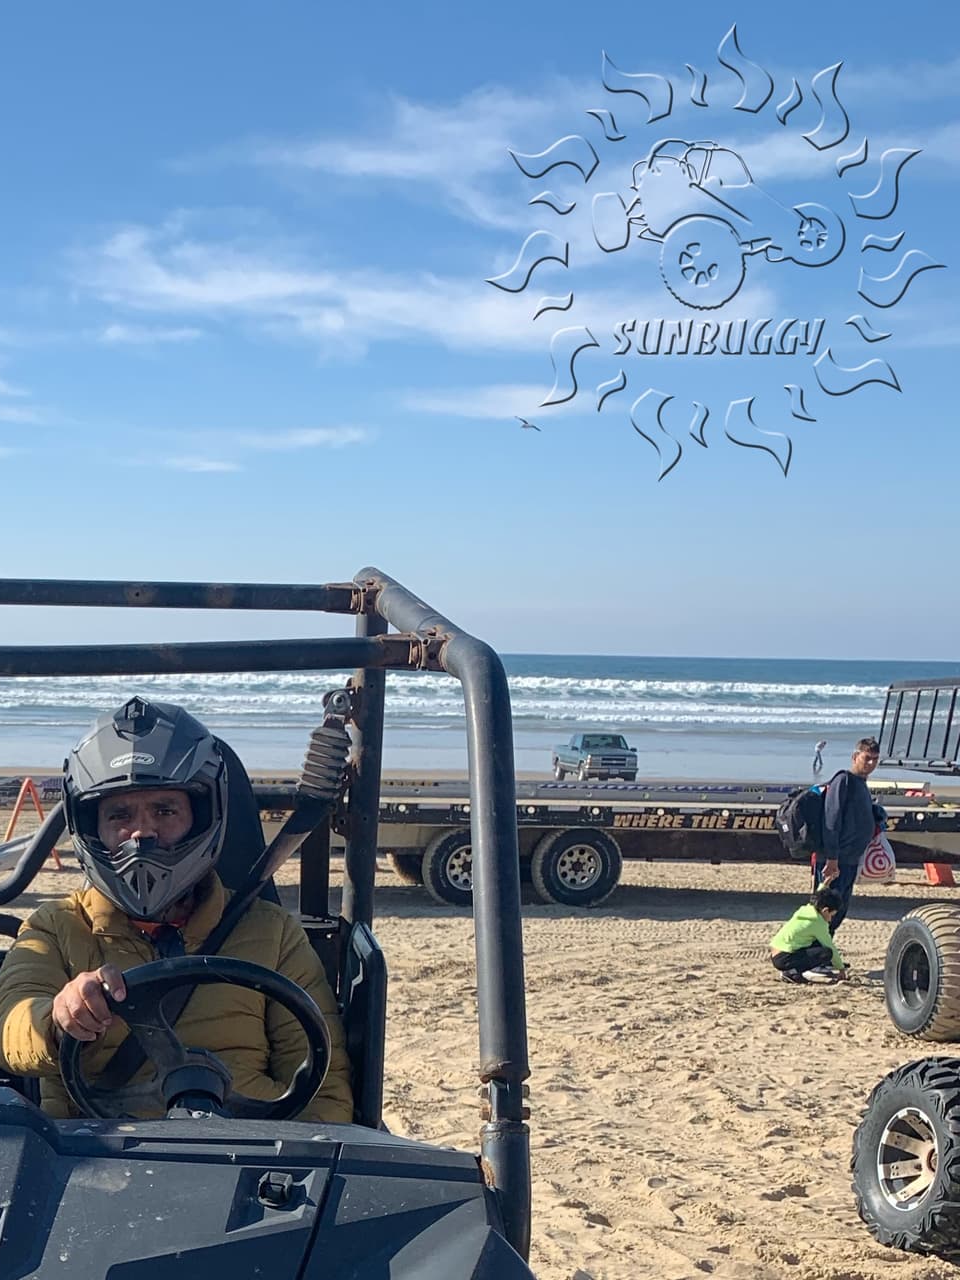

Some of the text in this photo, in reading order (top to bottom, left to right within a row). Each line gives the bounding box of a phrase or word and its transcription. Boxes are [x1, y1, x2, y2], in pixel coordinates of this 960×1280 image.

[613, 814, 775, 829] WHERE THE FUN
